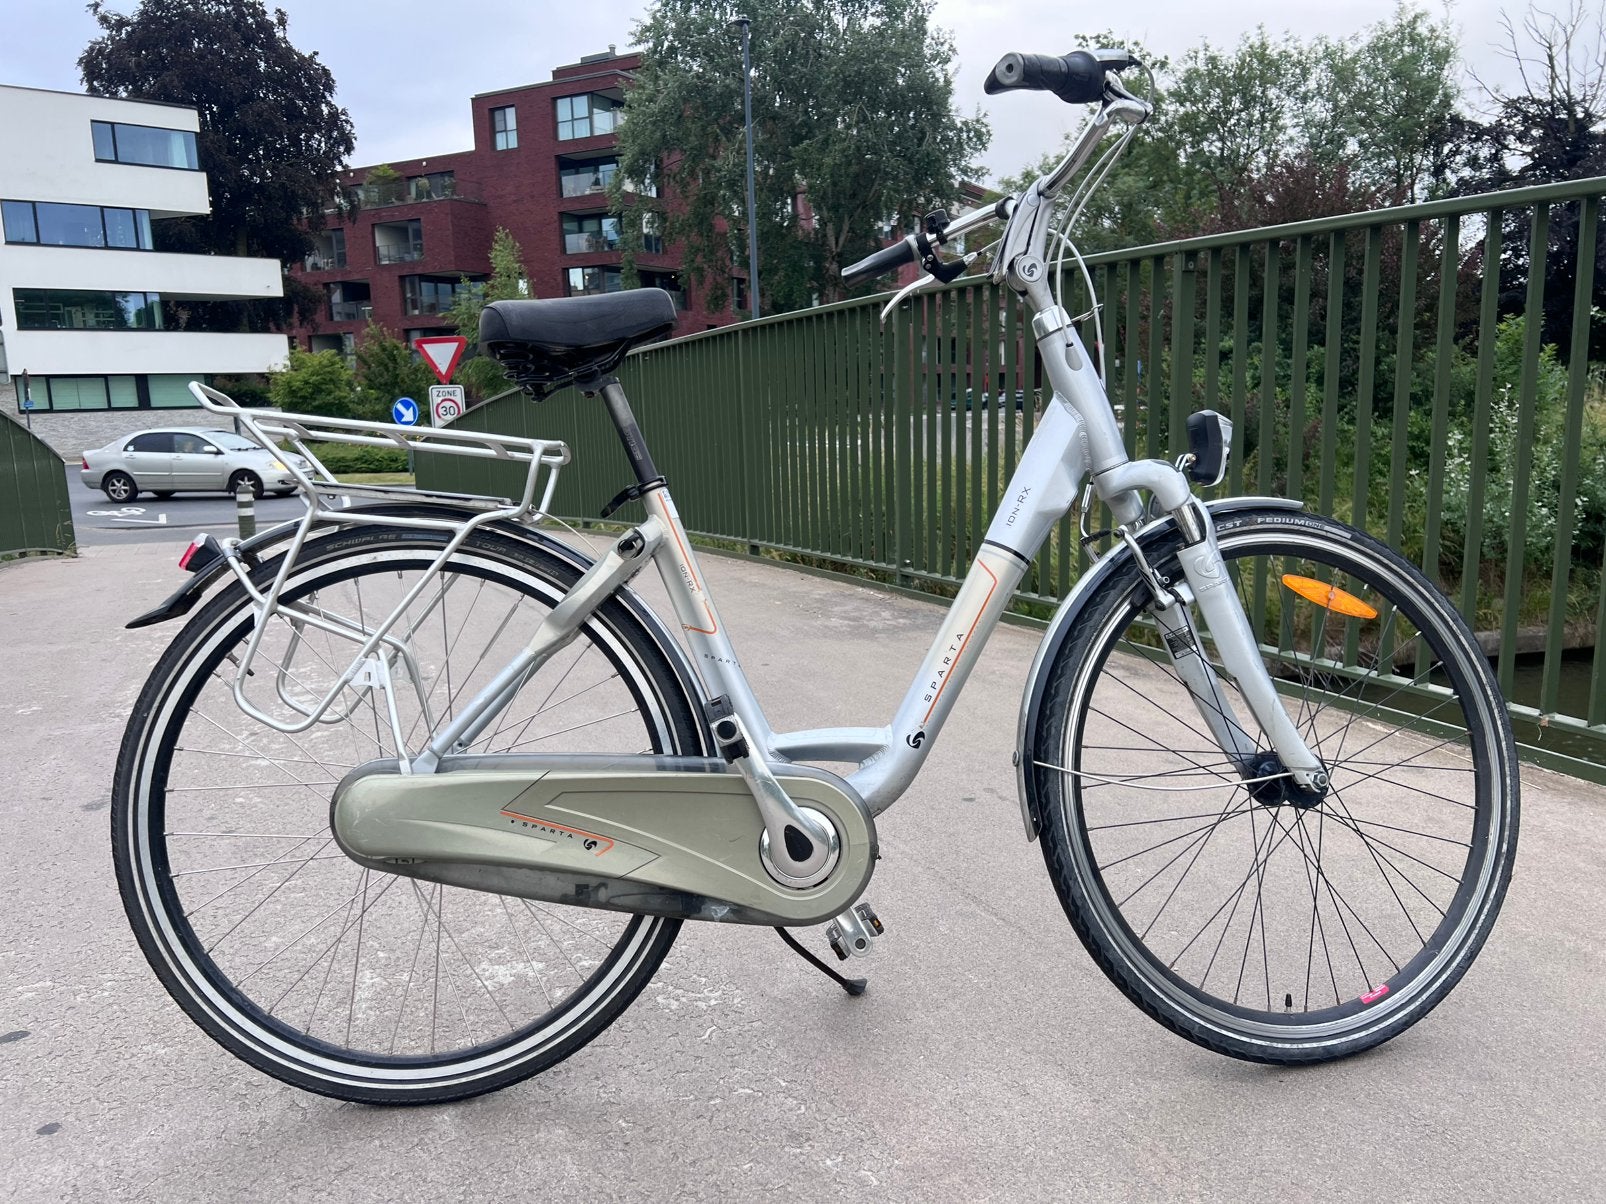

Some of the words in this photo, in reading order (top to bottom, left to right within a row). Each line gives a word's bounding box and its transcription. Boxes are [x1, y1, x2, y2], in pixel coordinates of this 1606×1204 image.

[441, 406, 456, 416] 30
[1006, 486, 1031, 526] ION-RX
[1216, 520, 1242, 531] CST
[679, 563, 696, 593] ION-RX
[924, 632, 964, 703] SPARTA
[522, 821, 574, 839] SPARTA
